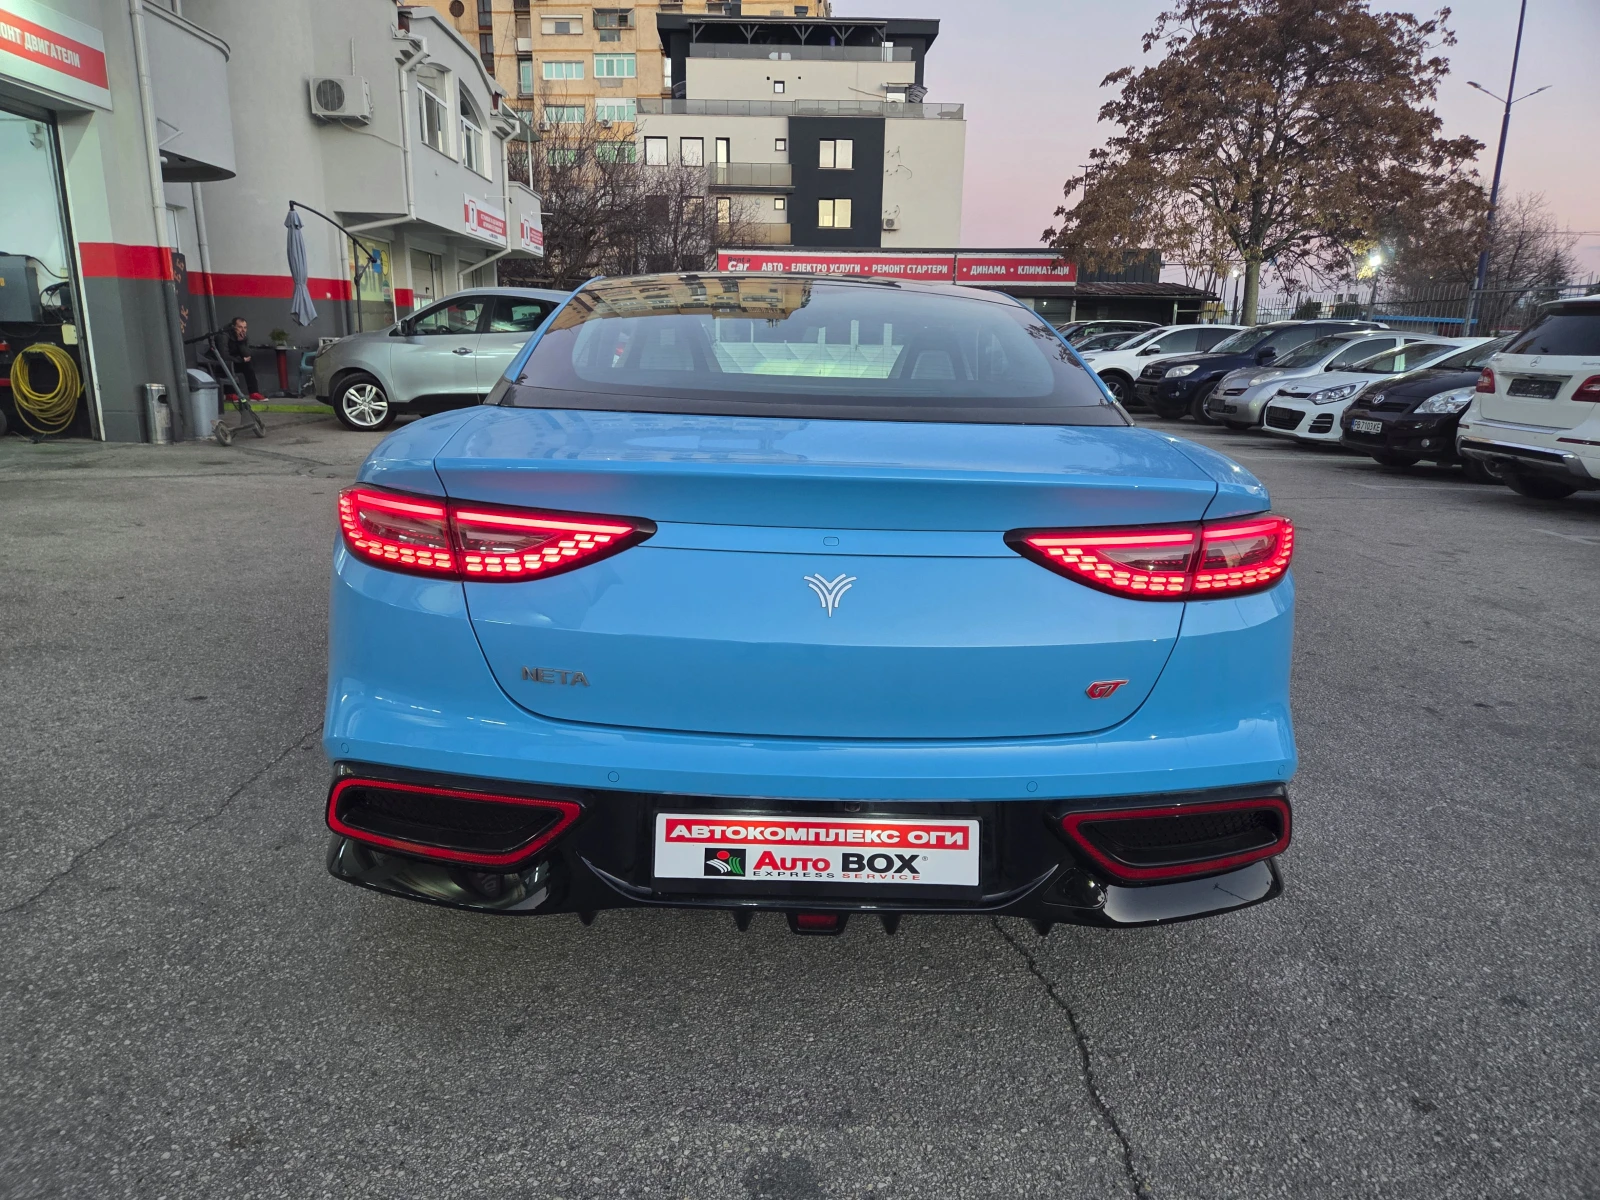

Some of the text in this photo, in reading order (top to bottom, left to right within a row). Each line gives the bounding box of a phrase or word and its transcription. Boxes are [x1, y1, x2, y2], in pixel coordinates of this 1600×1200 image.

[0, 22, 81, 68] ОНТ ДВИГАТЕЛИ
[727, 261, 750, 271] Car
[761, 262, 783, 272] АВТО
[791, 262, 827, 273] ЕЛЕКТРО
[829, 263, 861, 274] УСЛУГИ
[872, 264, 905, 273] РЕМОНТ
[906, 265, 948, 274] СТАРТЕРИ
[970, 265, 1006, 276] ДИНАМА
[522, 666, 590, 687] NETA
[1085, 679, 1129, 699] GT
[669, 824, 964, 845] АВТОКОМПЛЕКС ОГИ
